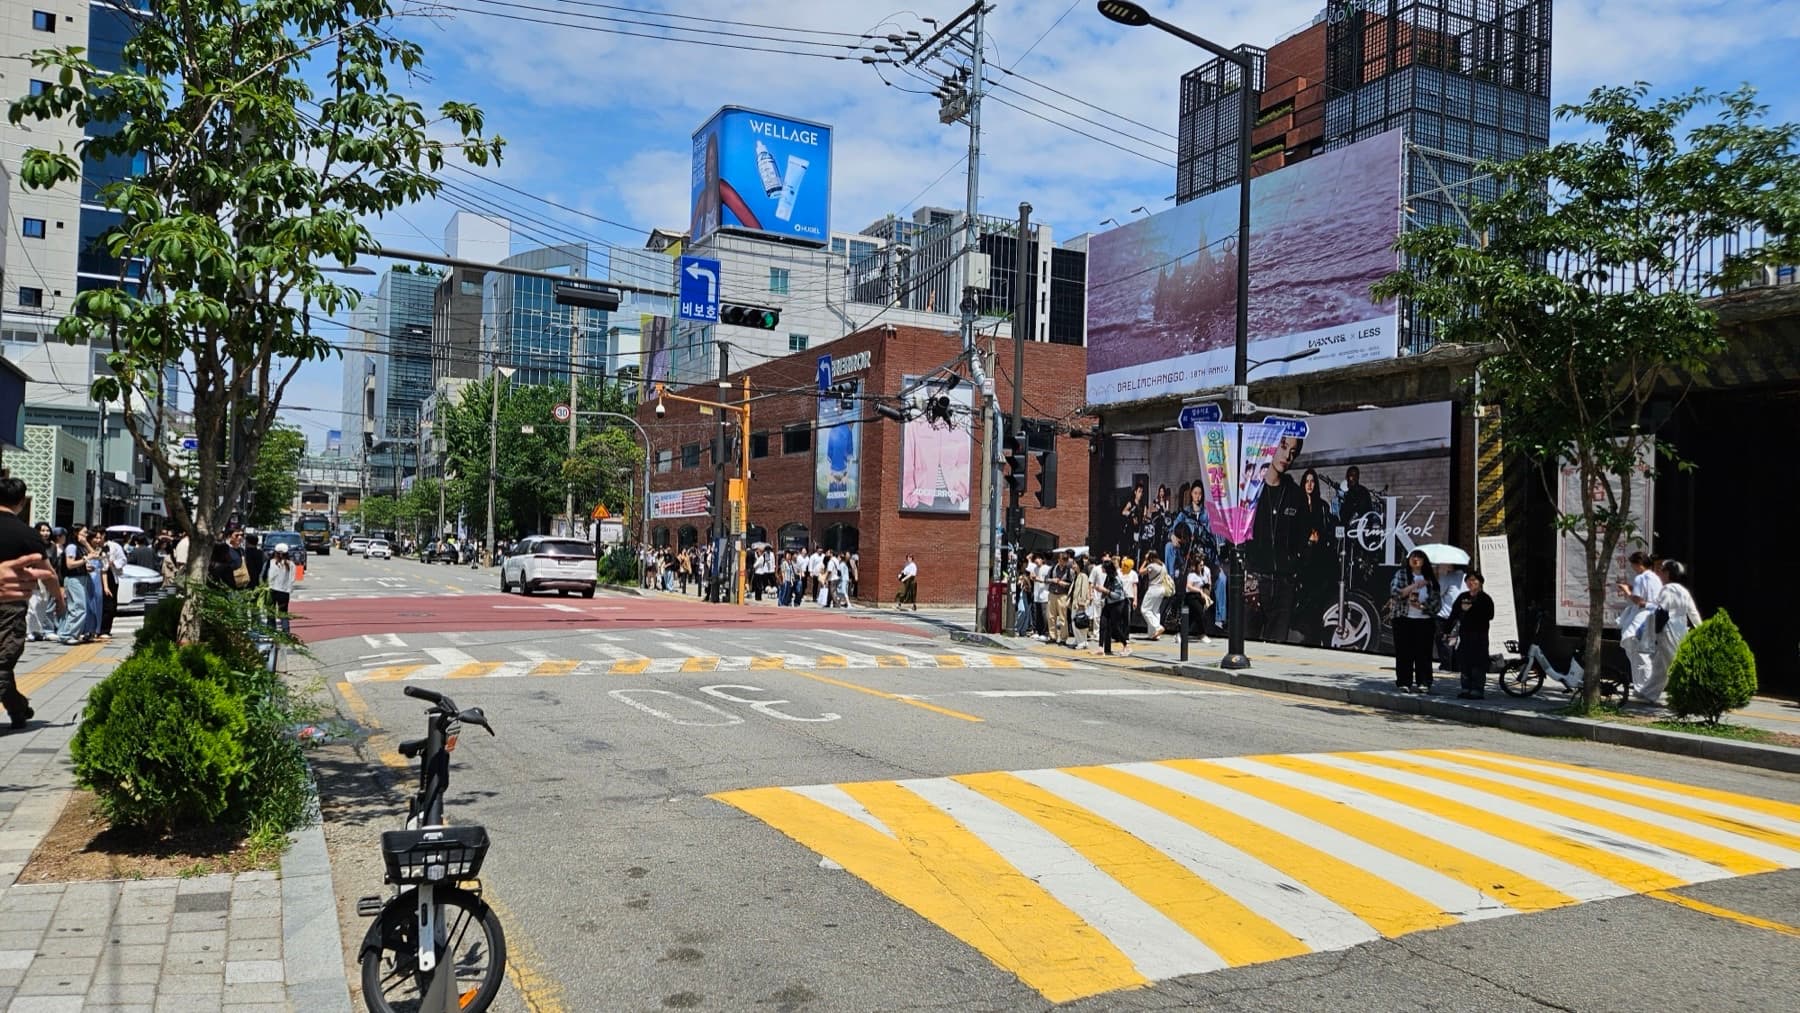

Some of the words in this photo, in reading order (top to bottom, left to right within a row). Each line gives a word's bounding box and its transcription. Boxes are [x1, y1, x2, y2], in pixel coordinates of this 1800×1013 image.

[749, 119, 819, 146] WELLAGE
[682, 302, 717, 319] 비보호
[1358, 327, 1381, 340] LESS
[557, 408, 567, 417] 30
